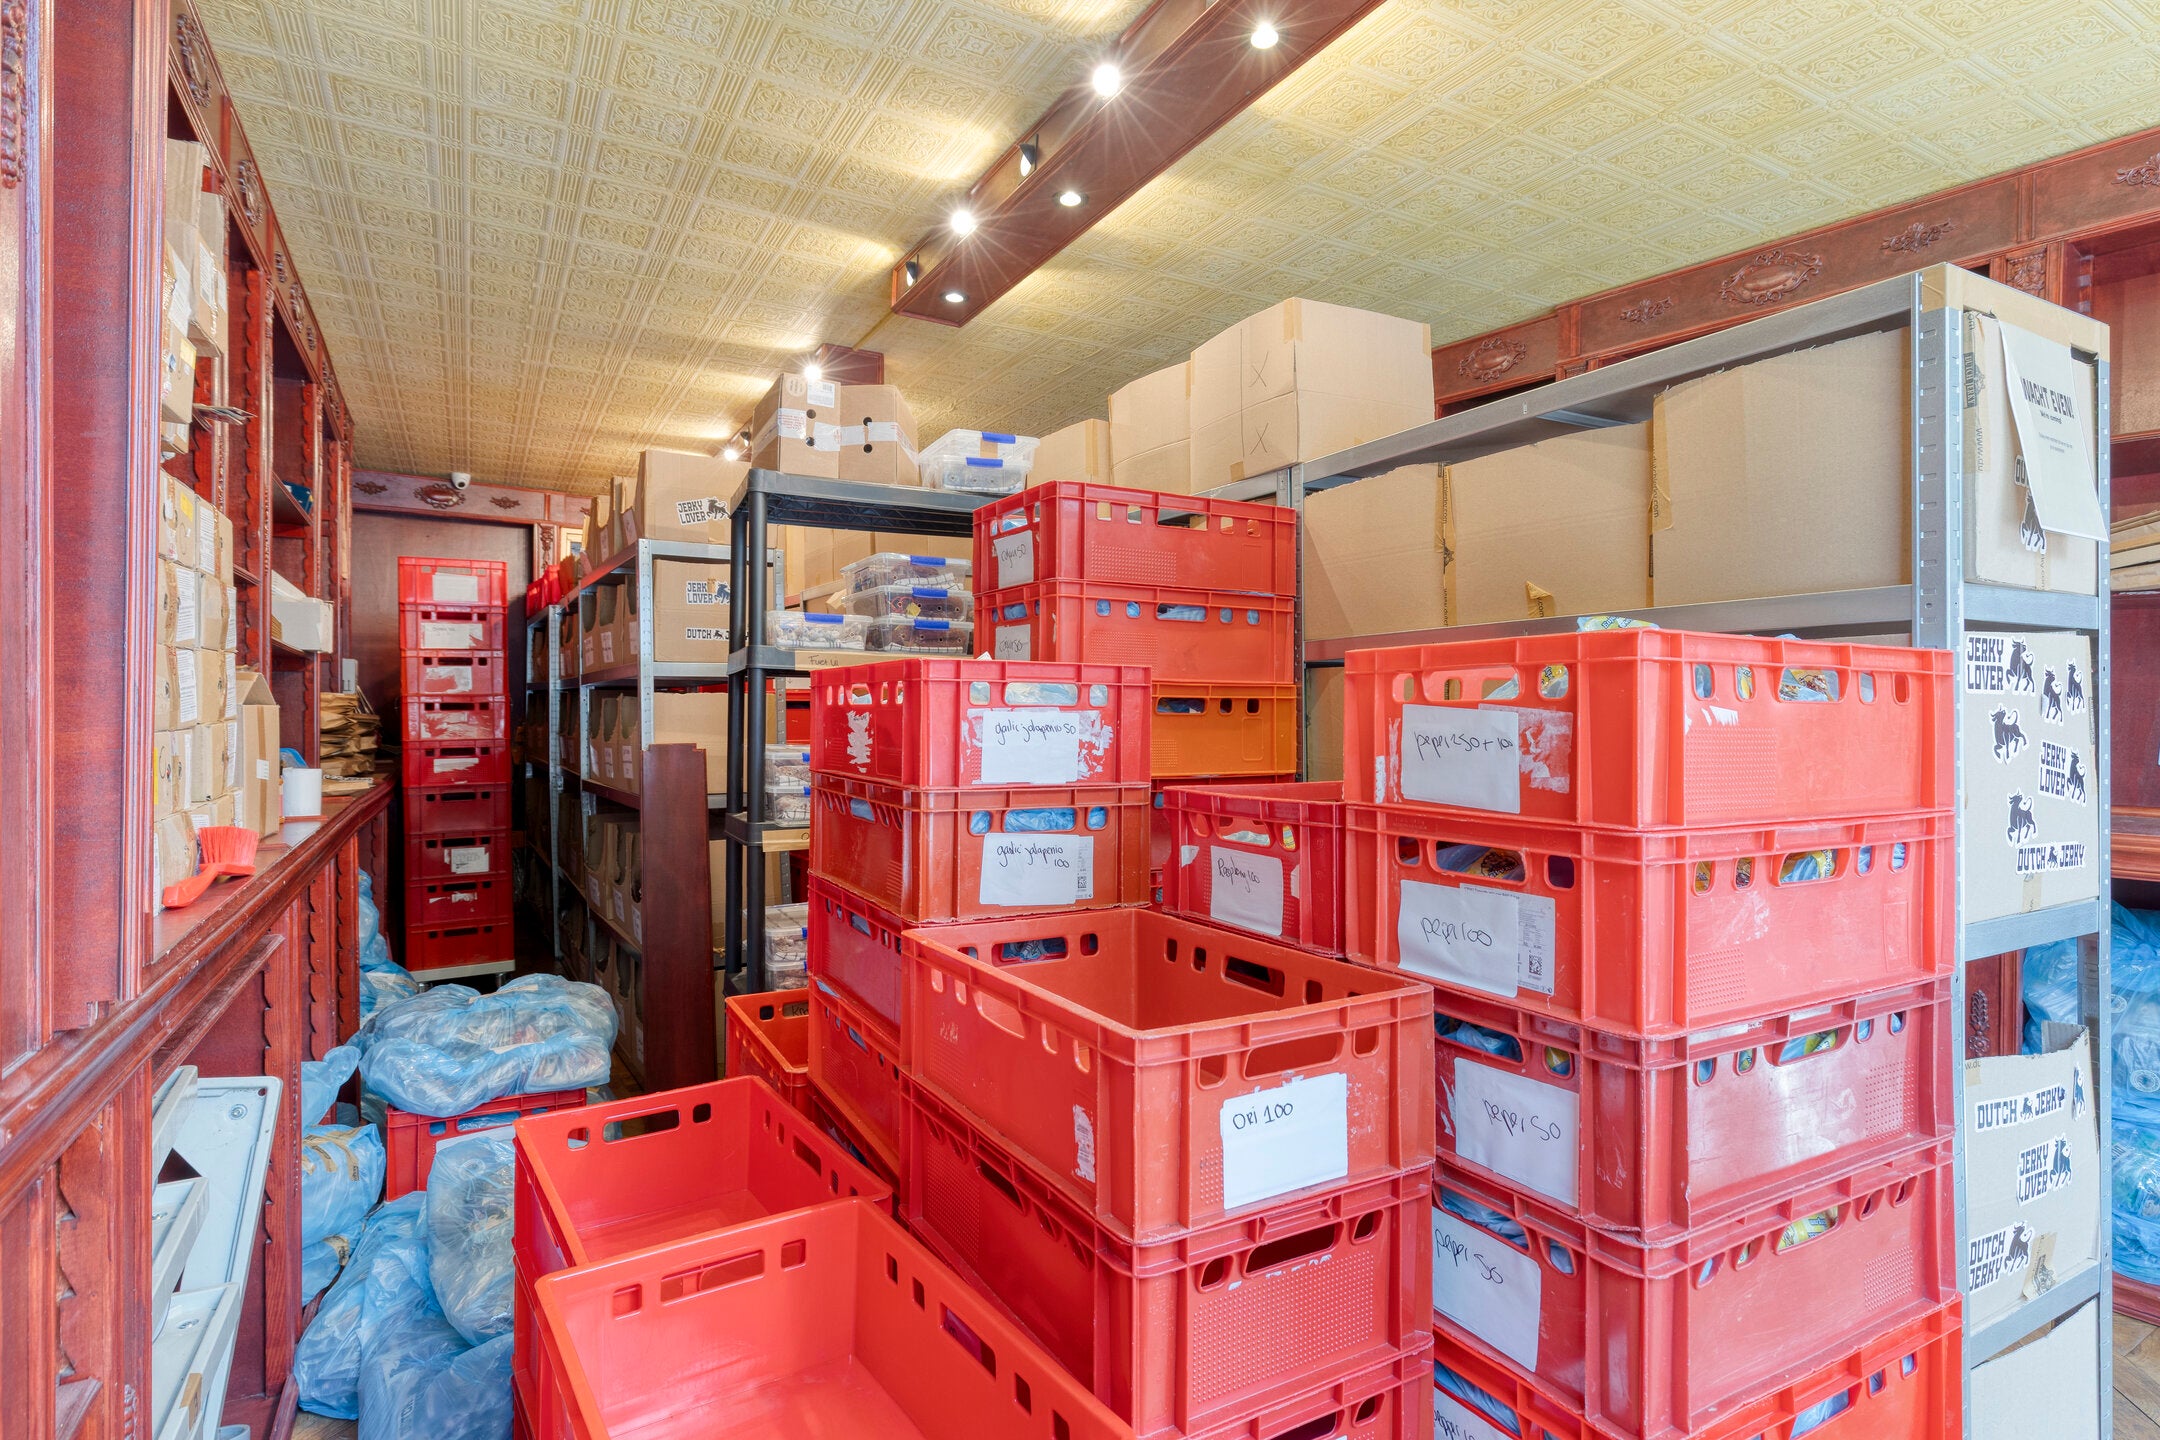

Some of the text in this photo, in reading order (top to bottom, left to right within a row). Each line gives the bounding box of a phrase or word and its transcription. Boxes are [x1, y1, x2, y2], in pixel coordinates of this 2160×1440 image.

[2020, 376, 2050, 410] WACHT
[2050, 389, 2075, 419] EVEN!
[678, 500, 703, 513] JERKY
[679, 511, 707, 524] LOVER
[687, 582, 709, 592] JERK
[687, 592, 714, 604] LOVER
[686, 628, 712, 640] DUTCH
[1967, 636, 2004, 662] JERKY
[1967, 664, 2004, 691] LOVER
[1063, 723, 1077, 735] 50
[2040, 741, 2067, 767] JERKY
[2039, 767, 2066, 798] LOVER
[1054, 858, 1070, 869] 100
[2017, 844, 2085, 872] DUTCH JERKY
[1461, 921, 1493, 947] 100
[1263, 1102, 1294, 1124] 100
[1977, 1086, 2066, 1129] DUTCH JERKY
[1530, 1115, 1562, 1142] 50
[2019, 1142, 2050, 1177] JERKY
[2018, 1169, 2049, 1202] LOVER
[1969, 1230, 2006, 1266] DUTCH
[1473, 1252, 1504, 1285] 50
[1968, 1256, 2004, 1292] JERKY
